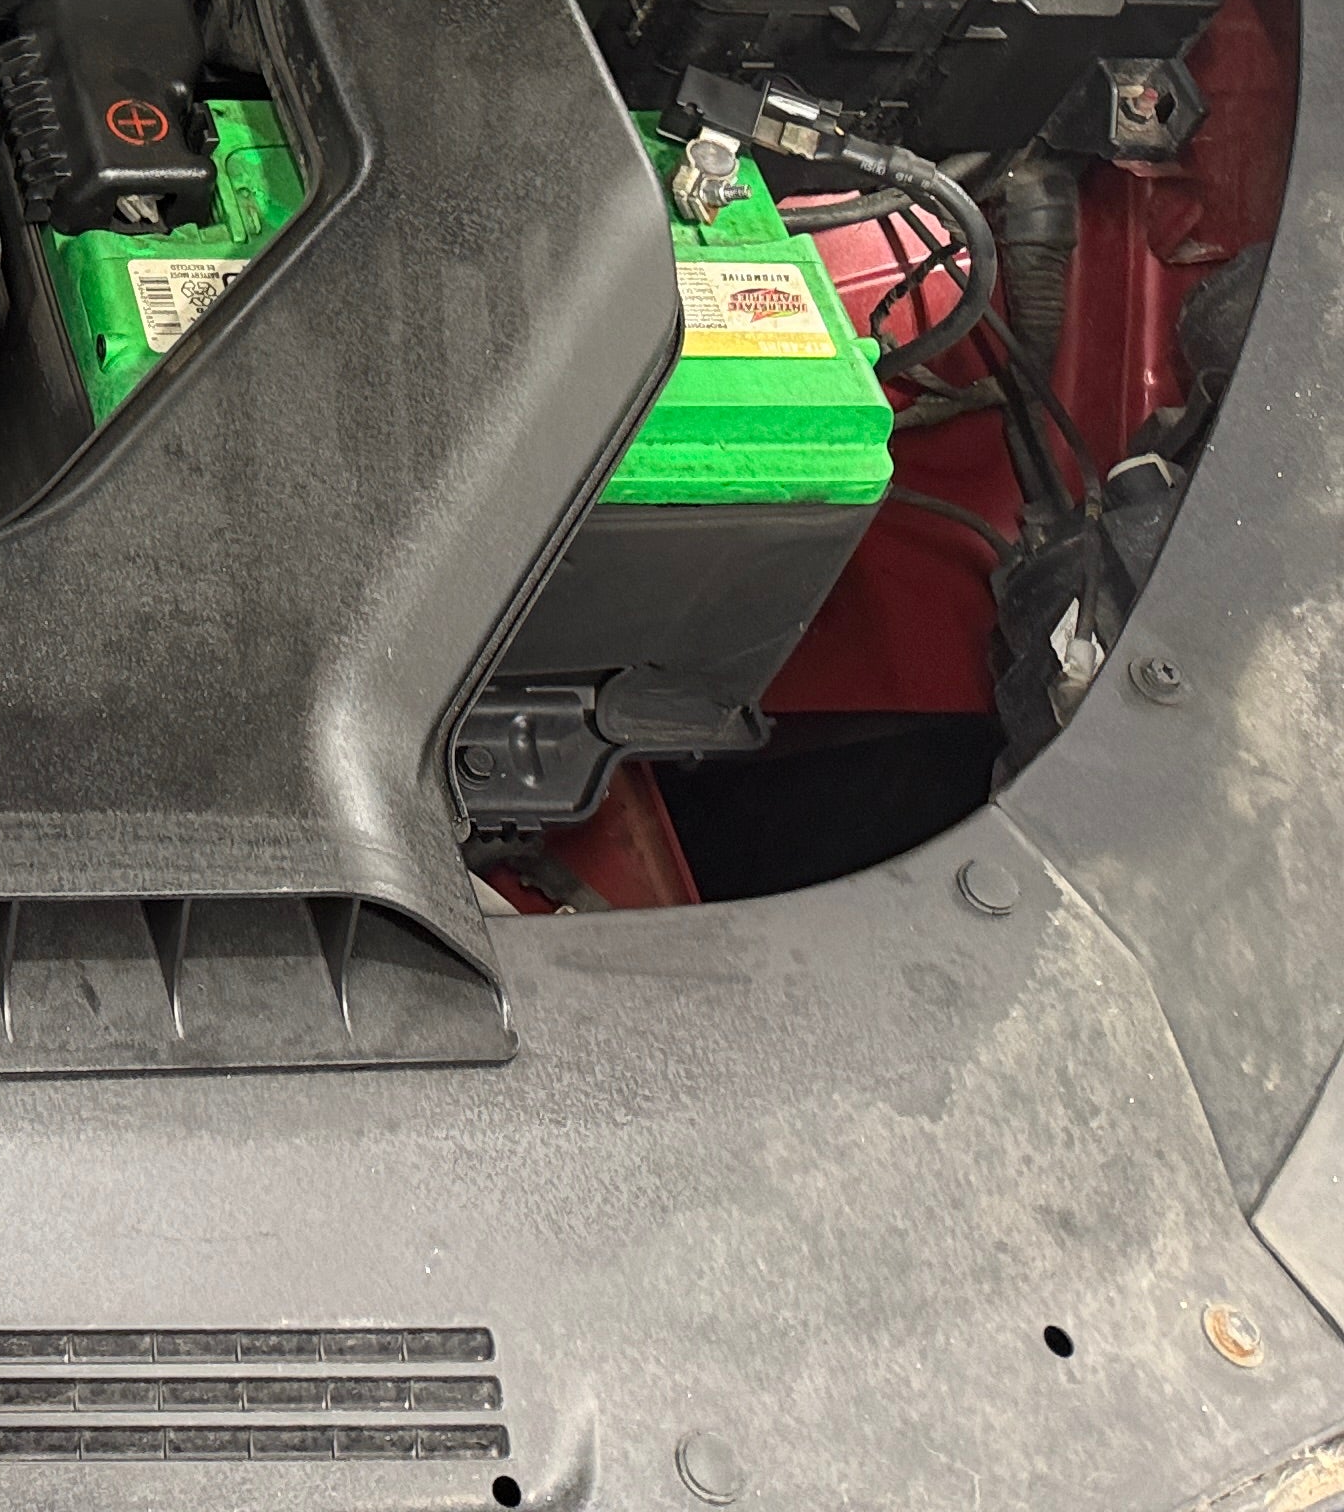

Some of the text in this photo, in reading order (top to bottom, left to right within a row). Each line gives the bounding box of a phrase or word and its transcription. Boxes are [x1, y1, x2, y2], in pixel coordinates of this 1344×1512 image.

[720, 273, 790, 283] AUTOMOTIVE
[730, 293, 802, 304] BATTERIES
[727, 302, 808, 314] INTERSTATE
